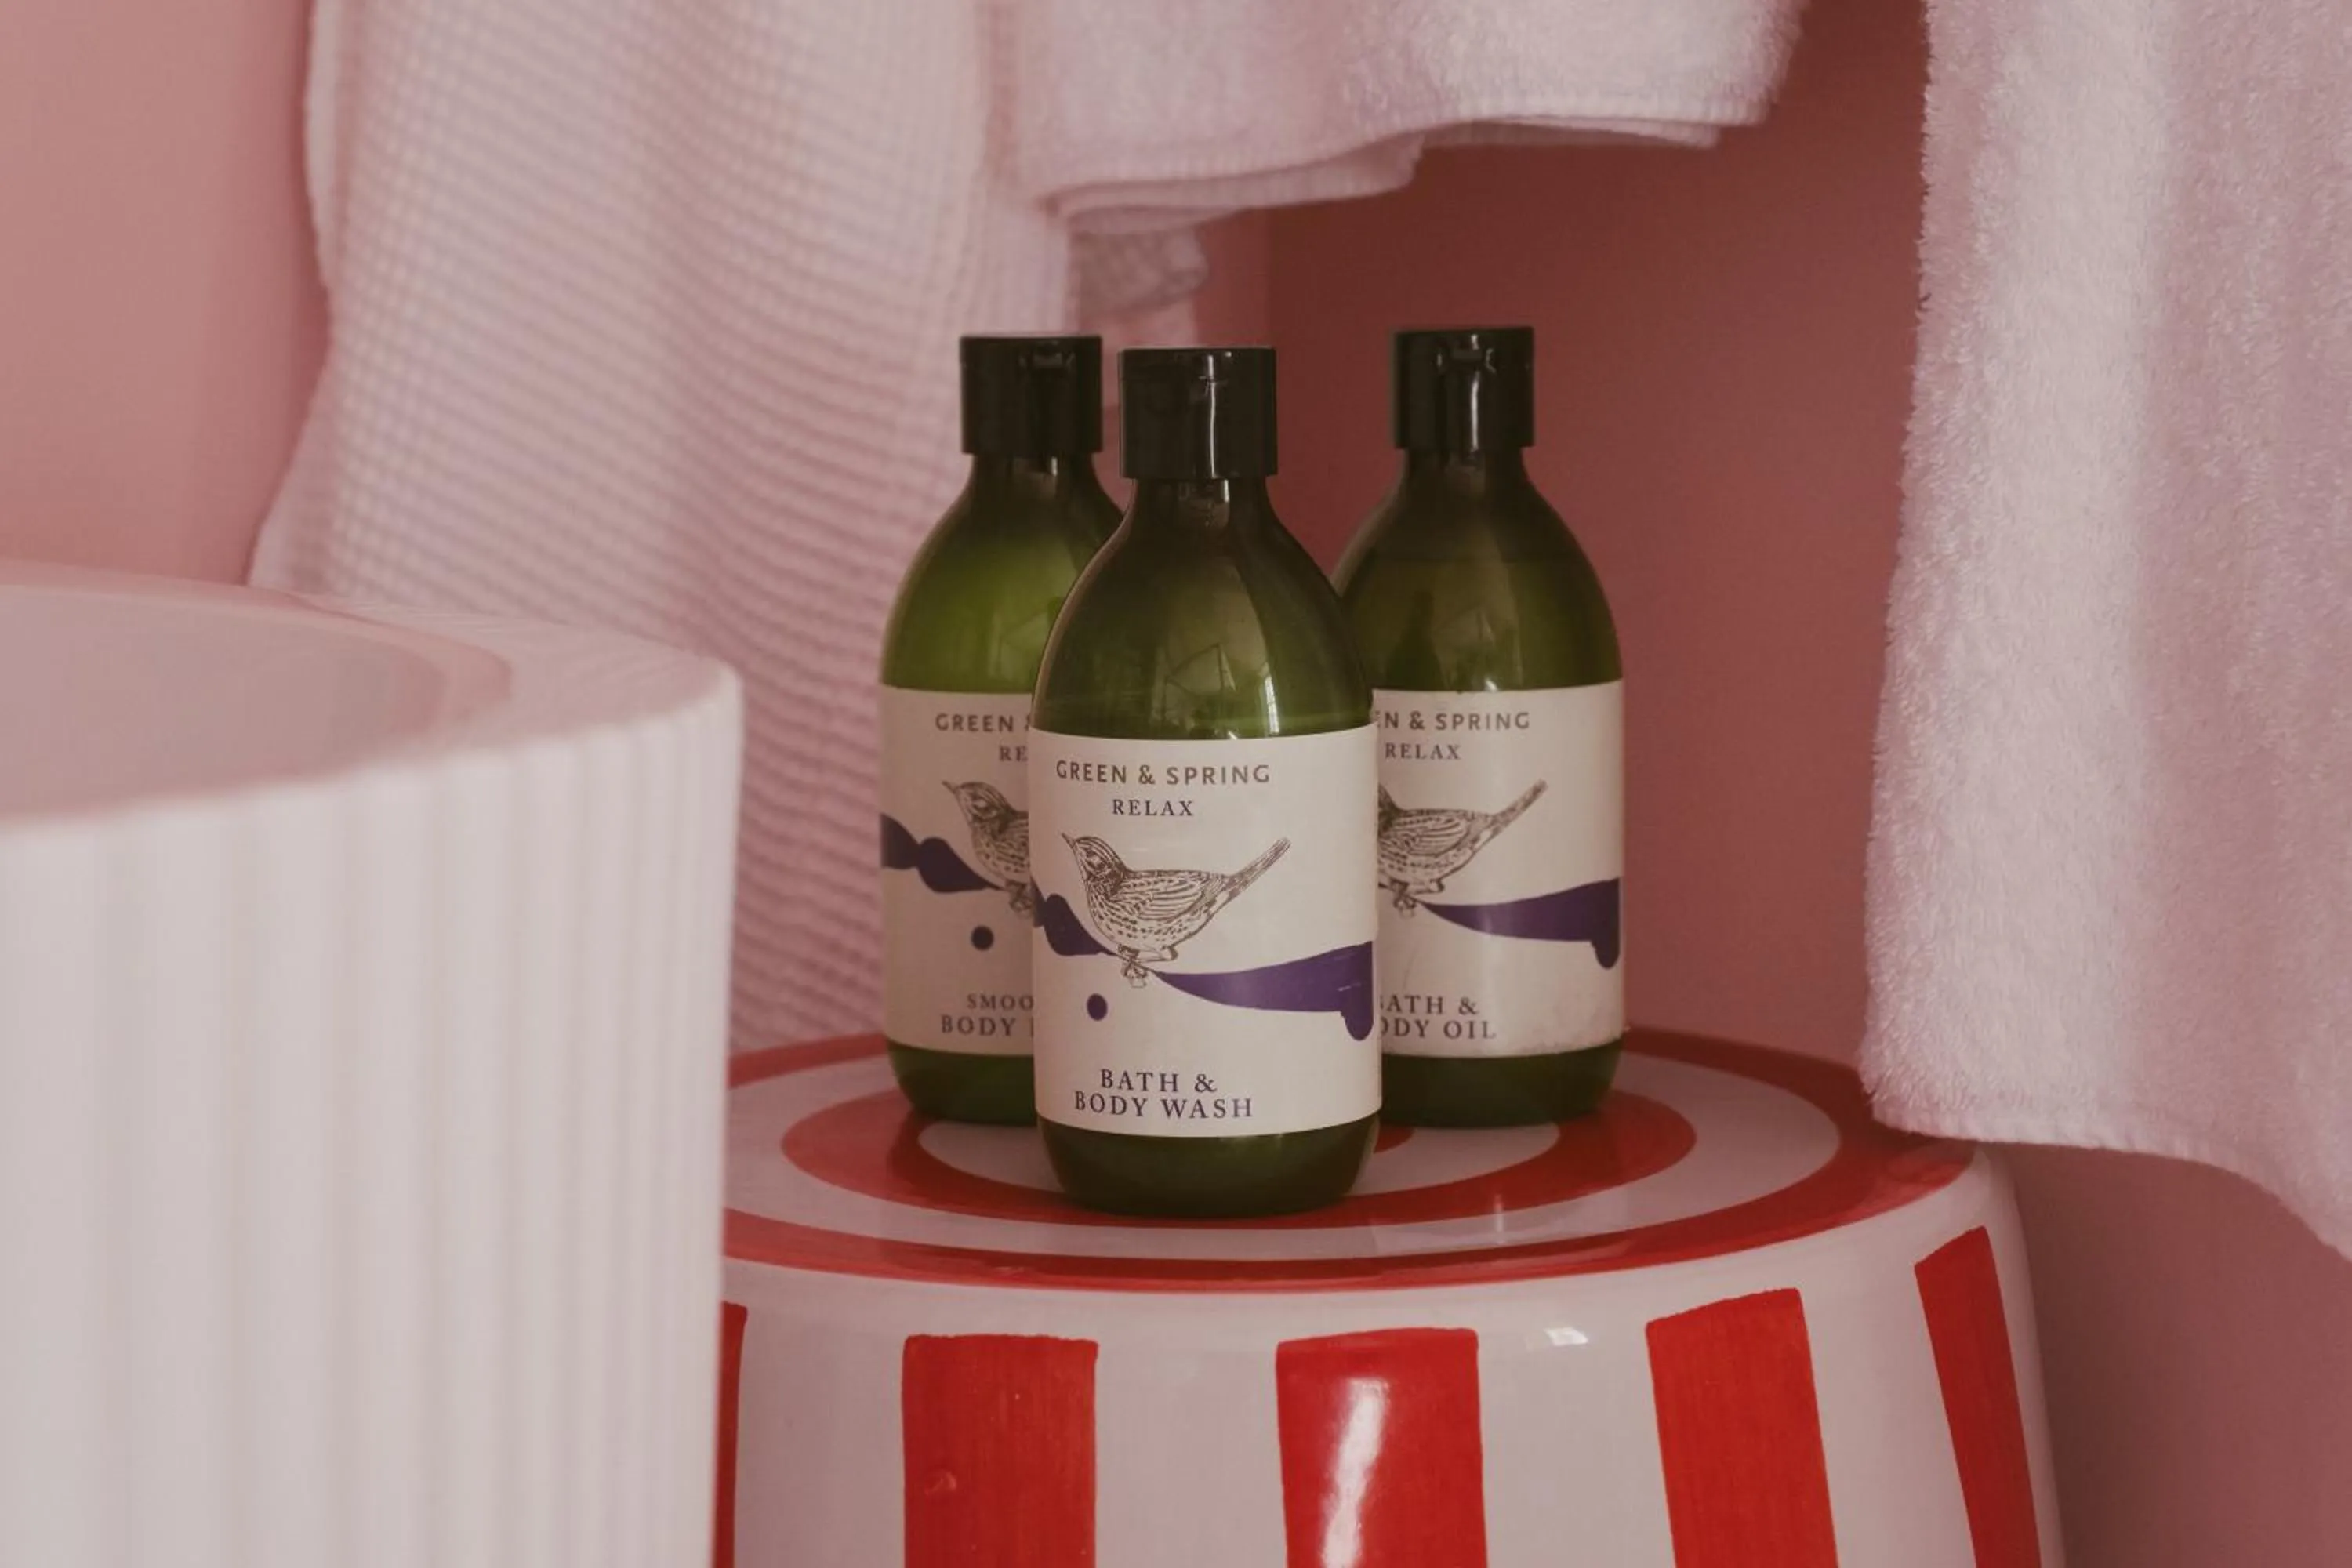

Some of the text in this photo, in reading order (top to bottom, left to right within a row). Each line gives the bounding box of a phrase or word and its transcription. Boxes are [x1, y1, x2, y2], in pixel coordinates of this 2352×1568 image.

[935, 713, 1014, 732] GREEN
[1410, 711, 1425, 730] &
[1435, 712, 1530, 731] SPRING
[1385, 742, 1461, 760] RELAX
[1056, 760, 1270, 785] GREEN & SPRING
[1112, 798, 1195, 816] RELAX
[1457, 996, 1479, 1015] &
[941, 1014, 1016, 1036] BODY
[1443, 1020, 1497, 1039] OIL
[1100, 1068, 1218, 1093] BATH &
[1074, 1091, 1253, 1119] BODY WASH
